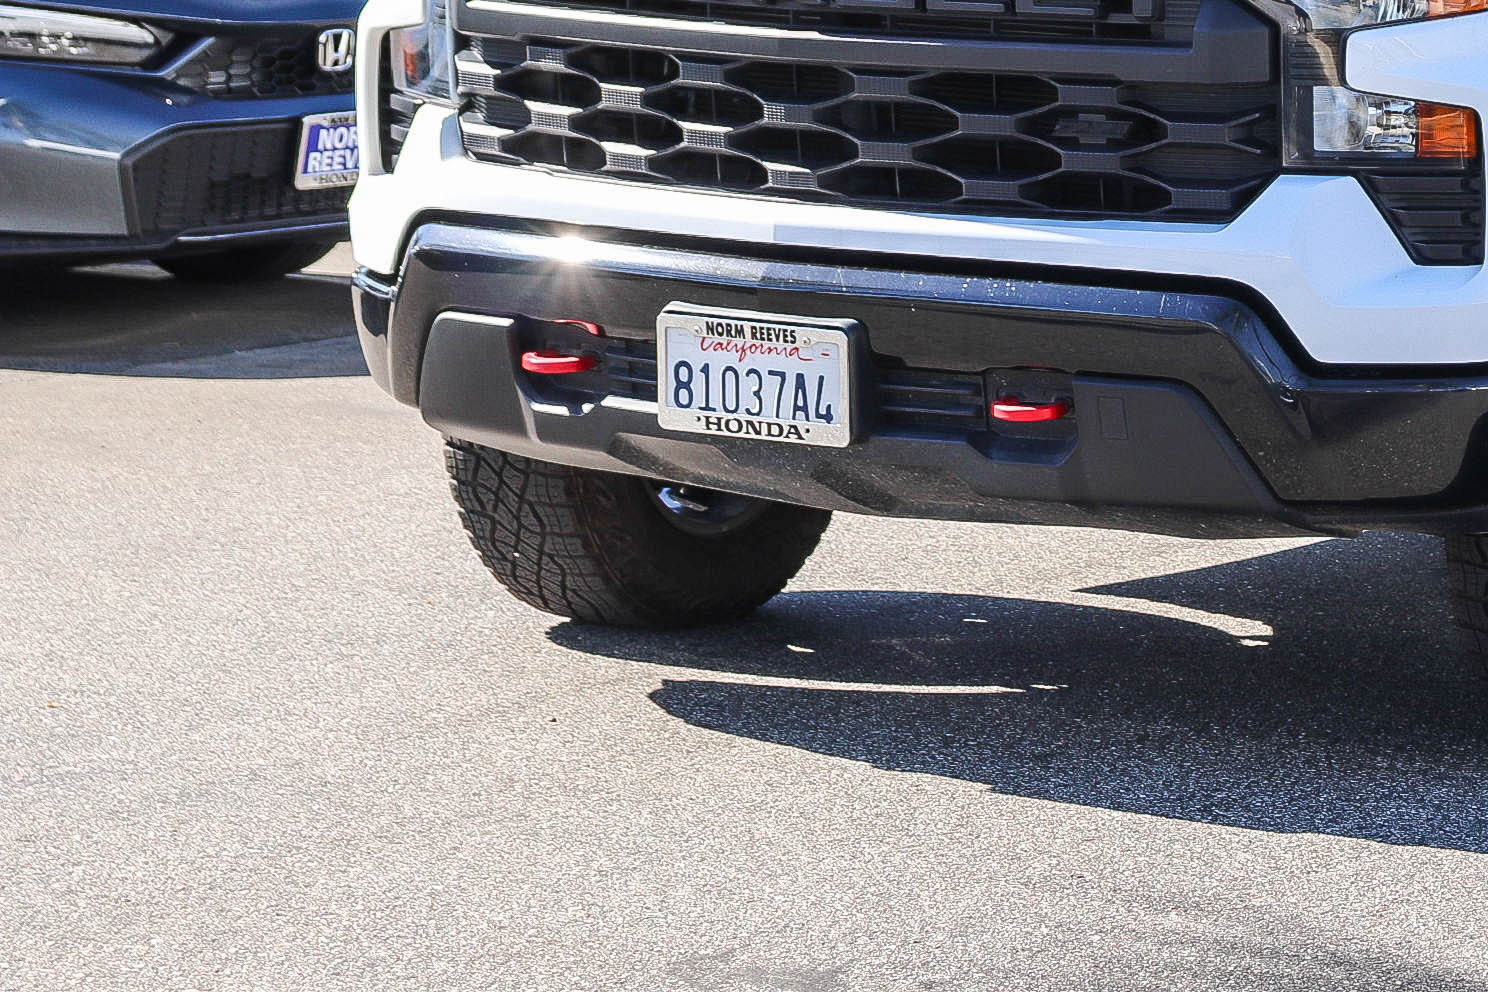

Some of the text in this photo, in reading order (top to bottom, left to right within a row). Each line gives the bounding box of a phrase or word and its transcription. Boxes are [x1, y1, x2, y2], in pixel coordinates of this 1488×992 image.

[705, 320, 797, 345] NORM REEVES
[700, 336, 813, 363] California
[673, 359, 834, 425] 81037A4
[703, 415, 806, 441] HONDA
